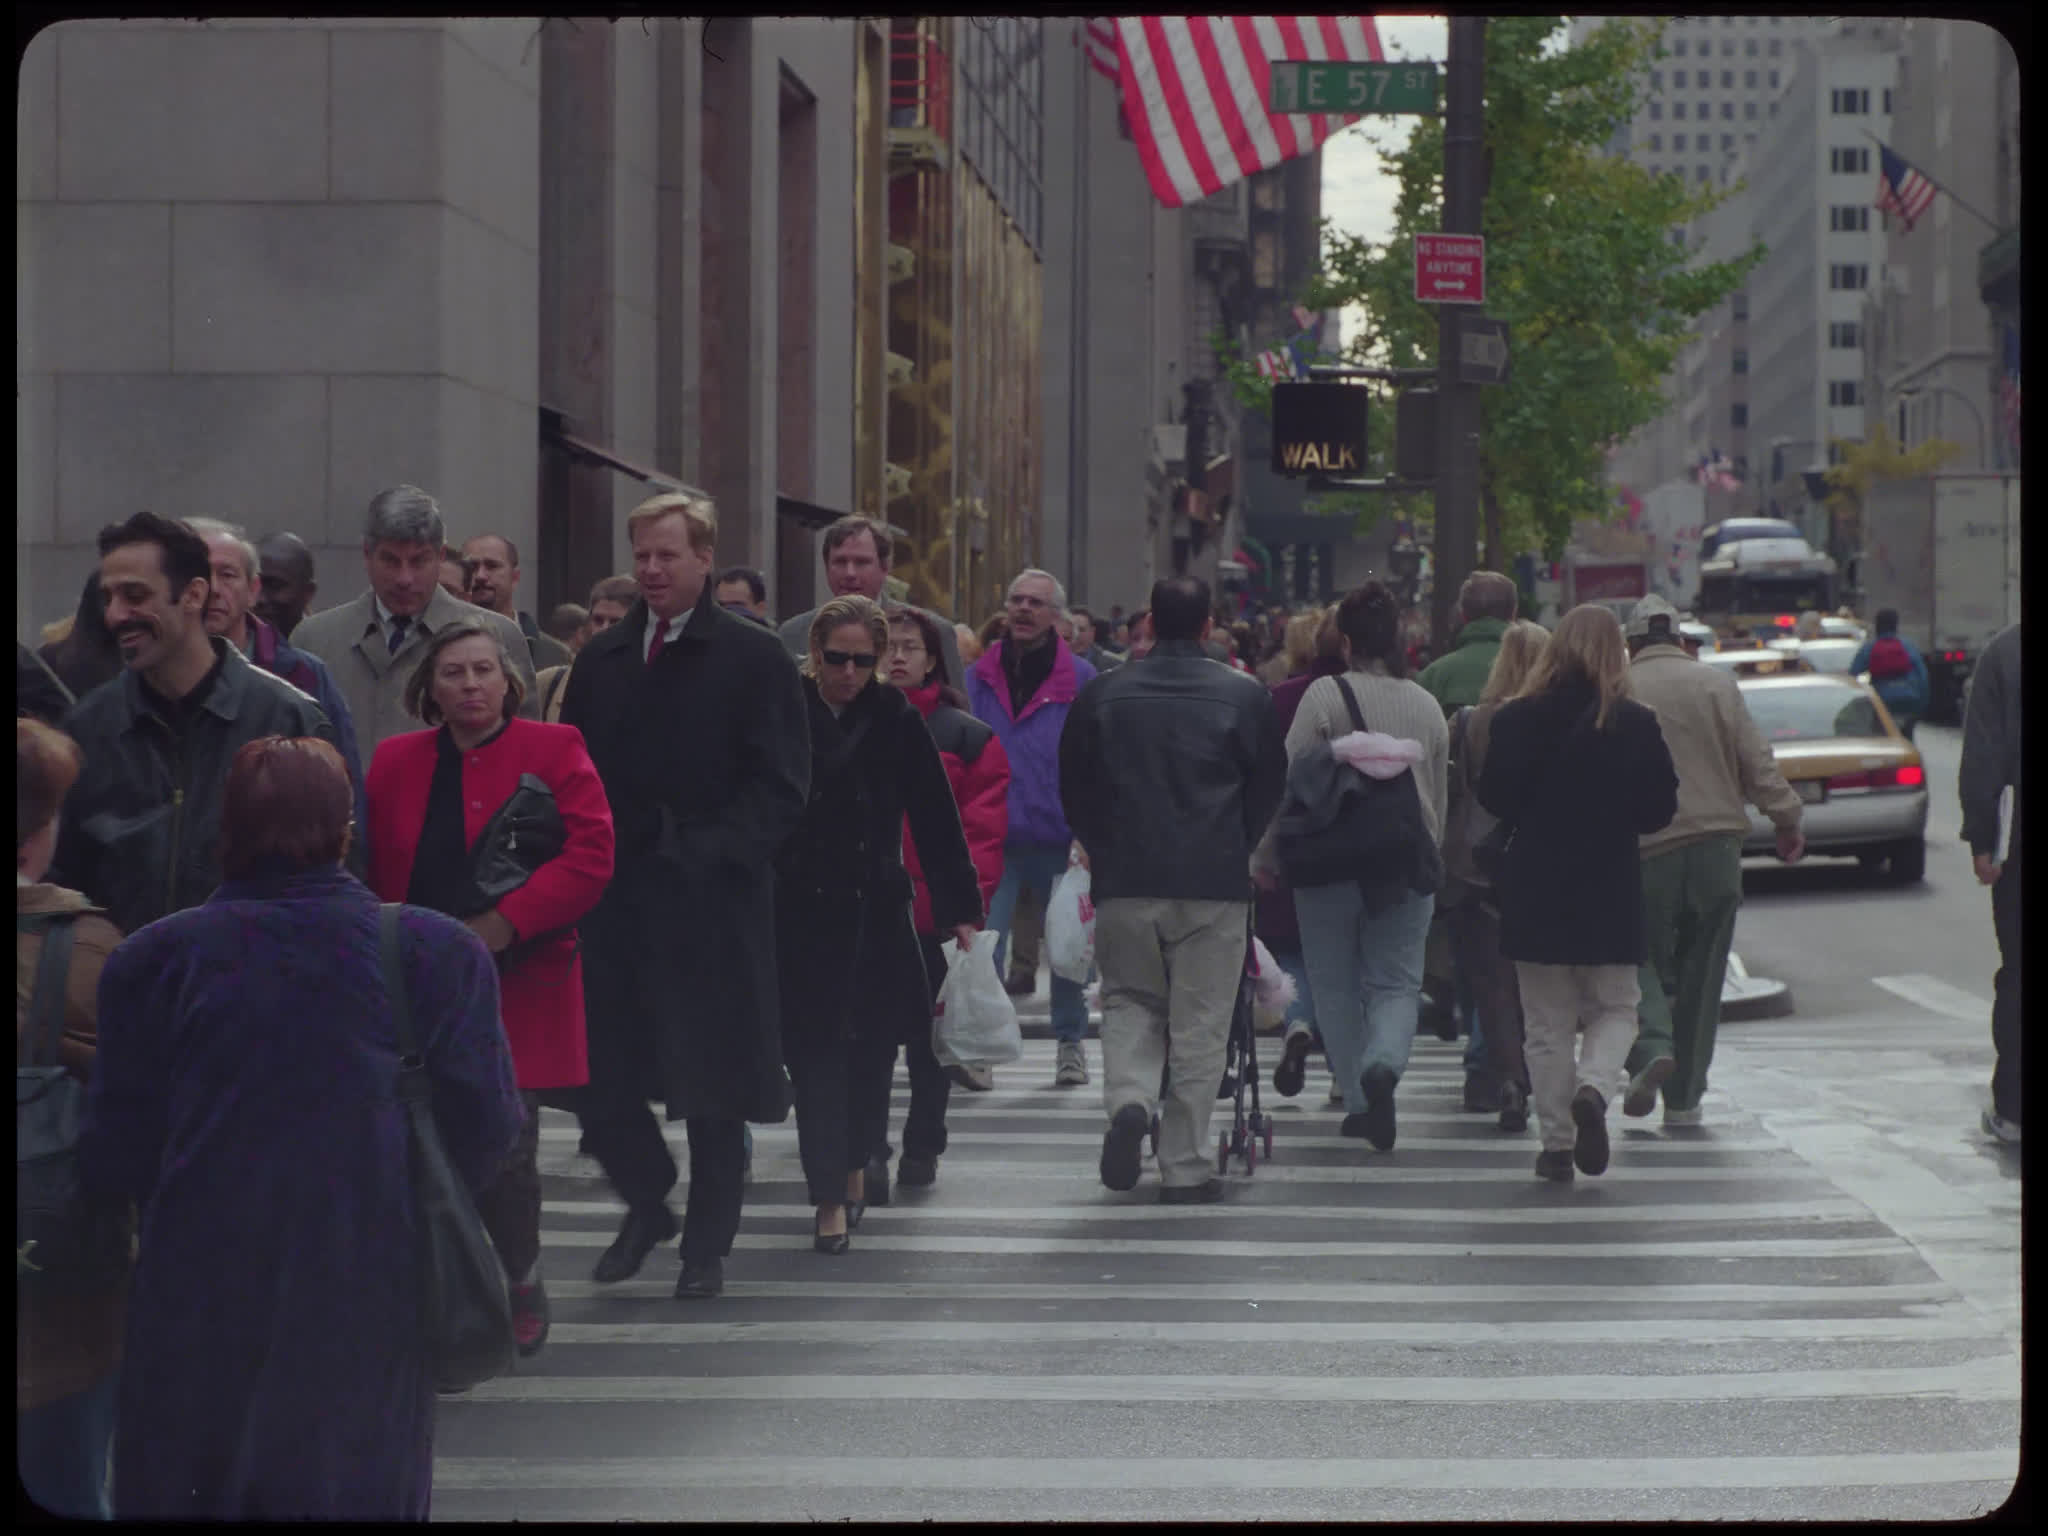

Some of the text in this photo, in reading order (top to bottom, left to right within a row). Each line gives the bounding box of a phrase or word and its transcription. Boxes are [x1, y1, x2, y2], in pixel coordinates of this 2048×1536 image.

[1307, 69, 1429, 106] E 57 ST
[1425, 261, 1473, 275] ANYTIME
[1280, 442, 1358, 469] WALK
